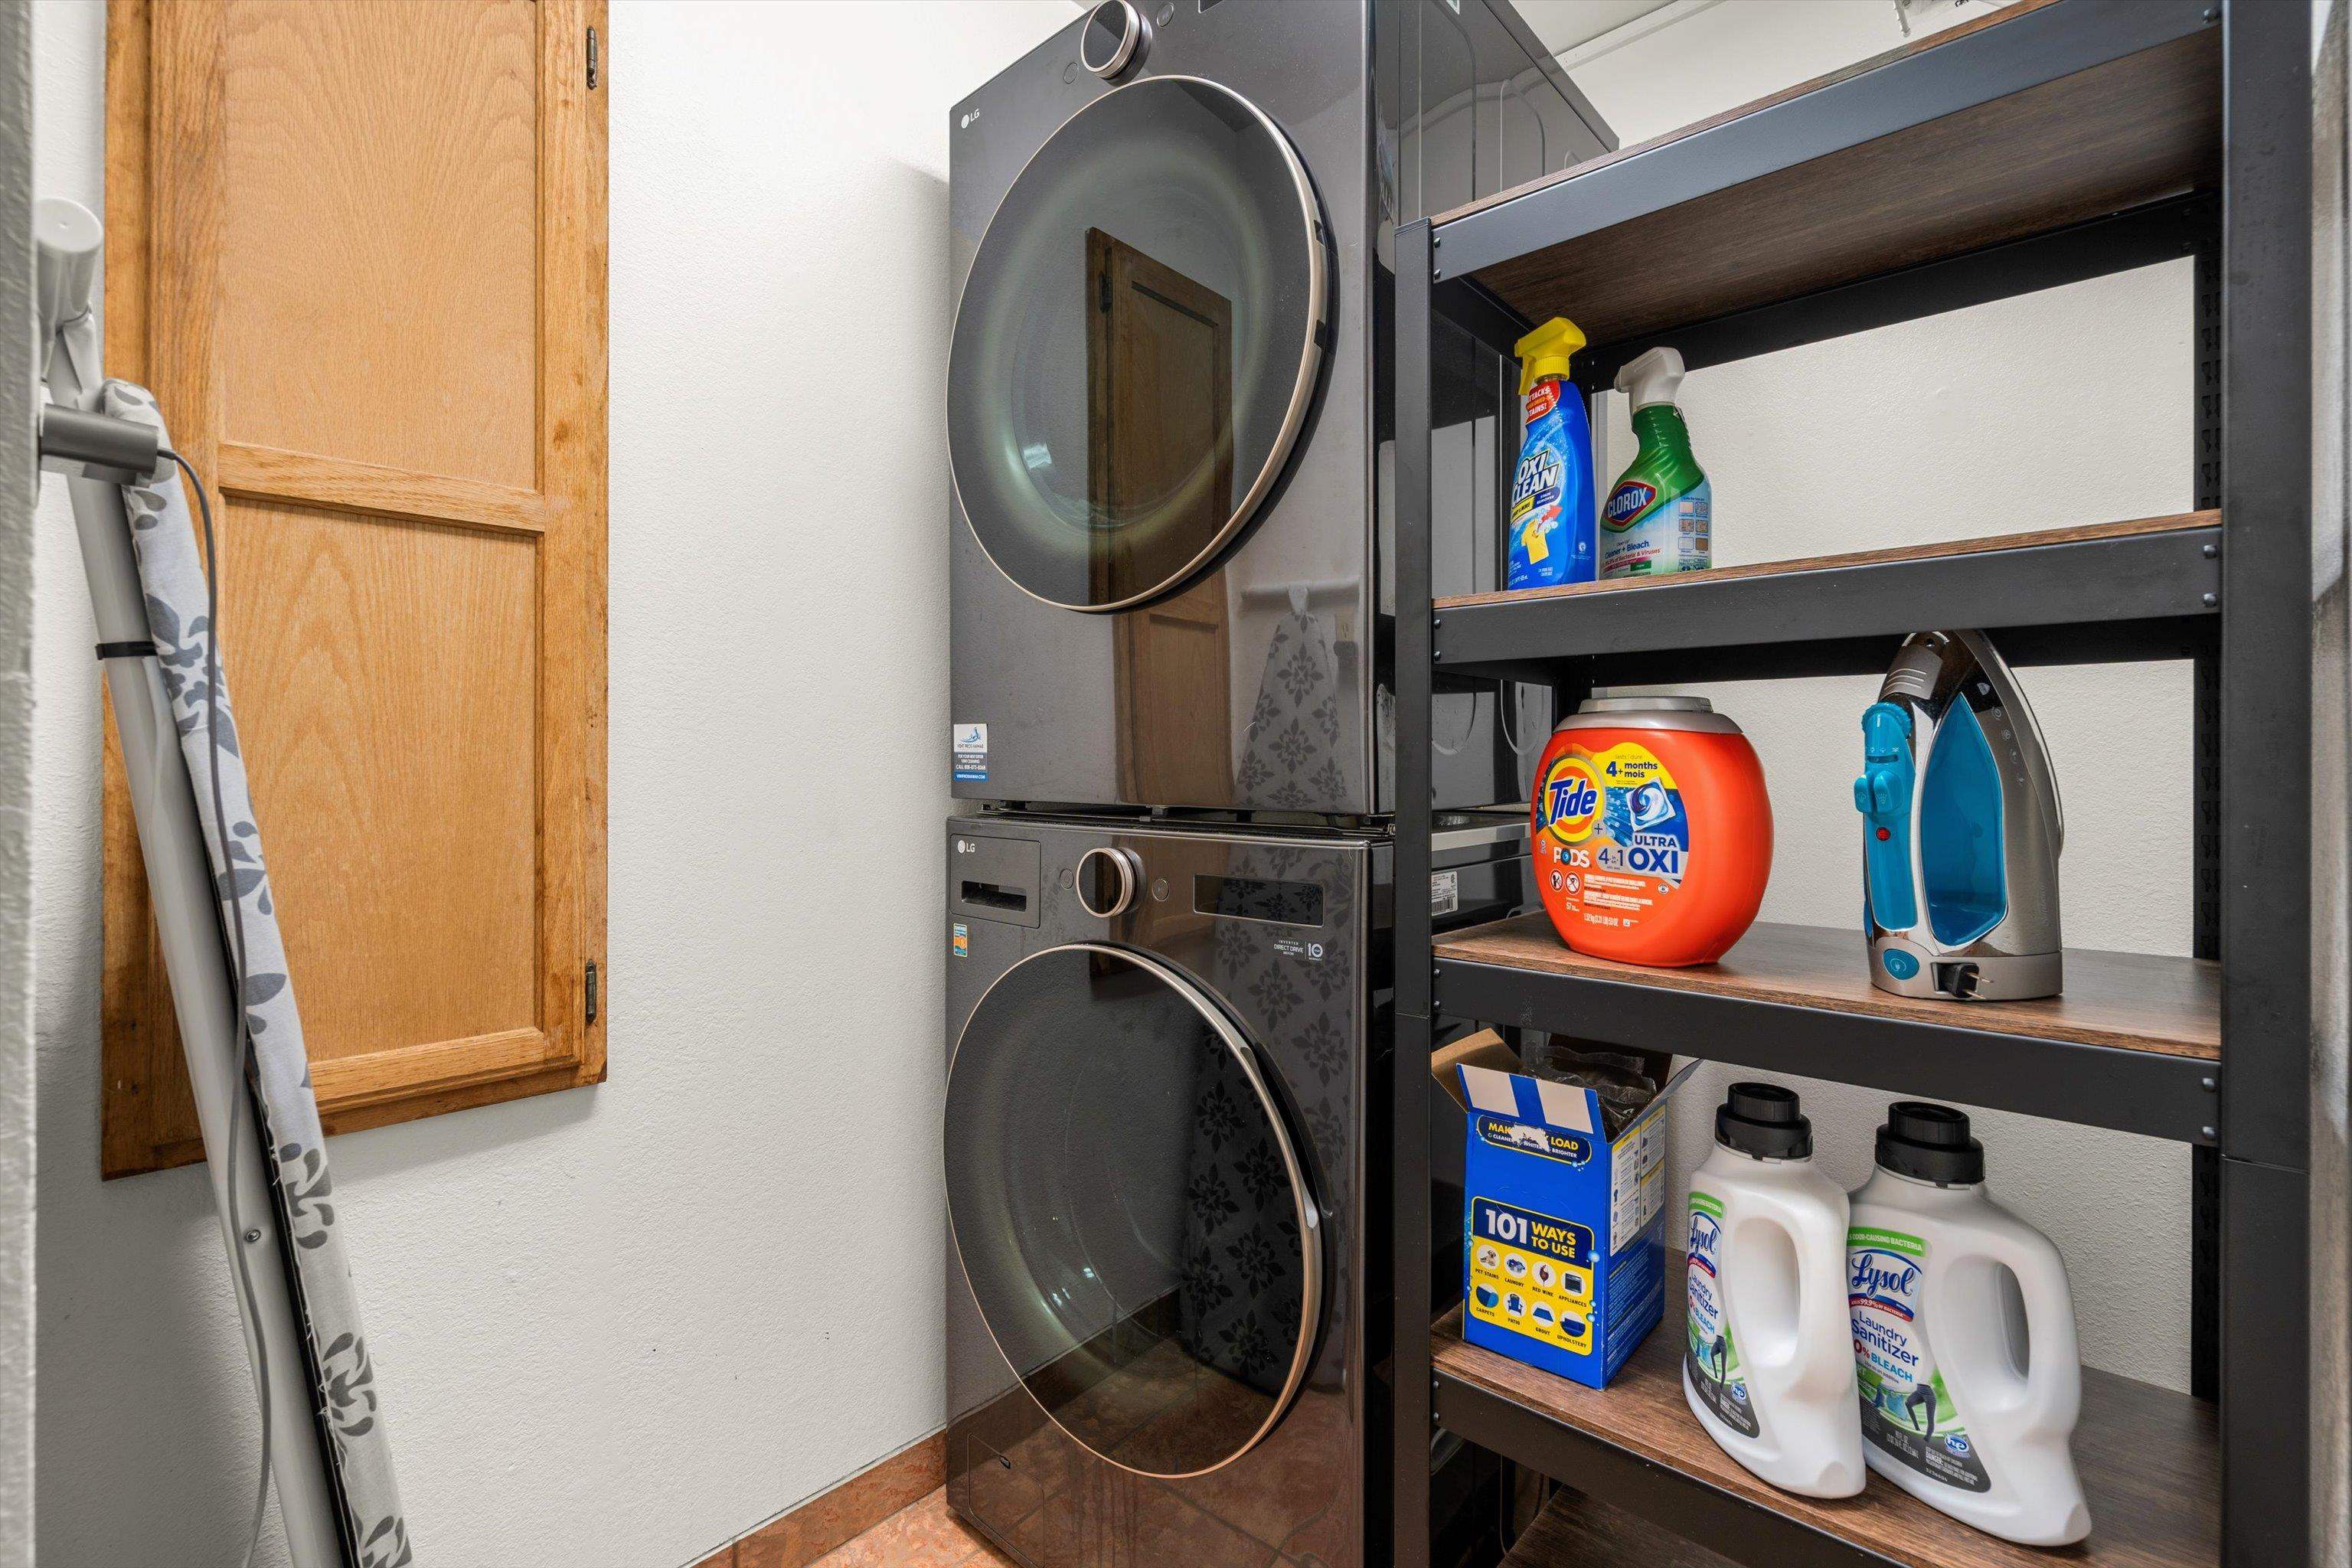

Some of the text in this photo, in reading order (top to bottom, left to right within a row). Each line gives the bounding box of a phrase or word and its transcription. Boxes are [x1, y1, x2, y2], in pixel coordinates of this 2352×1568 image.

[970, 108, 980, 122] LG
[1528, 402, 1547, 416] TAINS!
[1517, 449, 1550, 485] OXI
[1512, 462, 1560, 507] CLEAN
[1608, 486, 1648, 519] CLOROX
[1626, 540, 1649, 551] Bleach
[1624, 761, 1658, 770] months
[1624, 769, 1645, 778] mois
[1548, 778, 1598, 827] Tide
[965, 843, 975, 853] LG
[1634, 835, 1677, 848] ULTRA
[1628, 847, 1678, 874] OXI
[1273, 943, 1289, 952] DIRECT
[1488, 1122, 1512, 1135] MAK
[1550, 1136, 1579, 1151] LOAD
[1551, 1148, 1578, 1158] BRIGHTER
[1485, 1208, 1576, 1246] 101 WAYS
[1689, 1216, 1717, 1256] Lysol
[1531, 1236, 1576, 1259] TO USE
[1890, 1237, 1923, 1252] BACTERIA
[1484, 1270, 1499, 1280] STAINS
[1851, 1253, 1914, 1298] Lysol
[1690, 1268, 1713, 1301] Laundry
[1558, 1295, 1587, 1308] APPLIANCES
[1688, 1282, 1719, 1320] Sanitizer
[1860, 1298, 1879, 1309] 99.9%
[1475, 1307, 1495, 1317] CARPETS
[1507, 1317, 1521, 1326] PATIO
[1859, 1311, 1907, 1347] Laundry
[1535, 1327, 1550, 1335] GROUT
[1557, 1334, 1587, 1349] UPHOLSTERY
[1851, 1318, 1919, 1367] Sanitizer
[1854, 1338, 1870, 1359] 0%
[1871, 1352, 1913, 1383] BLEACH
